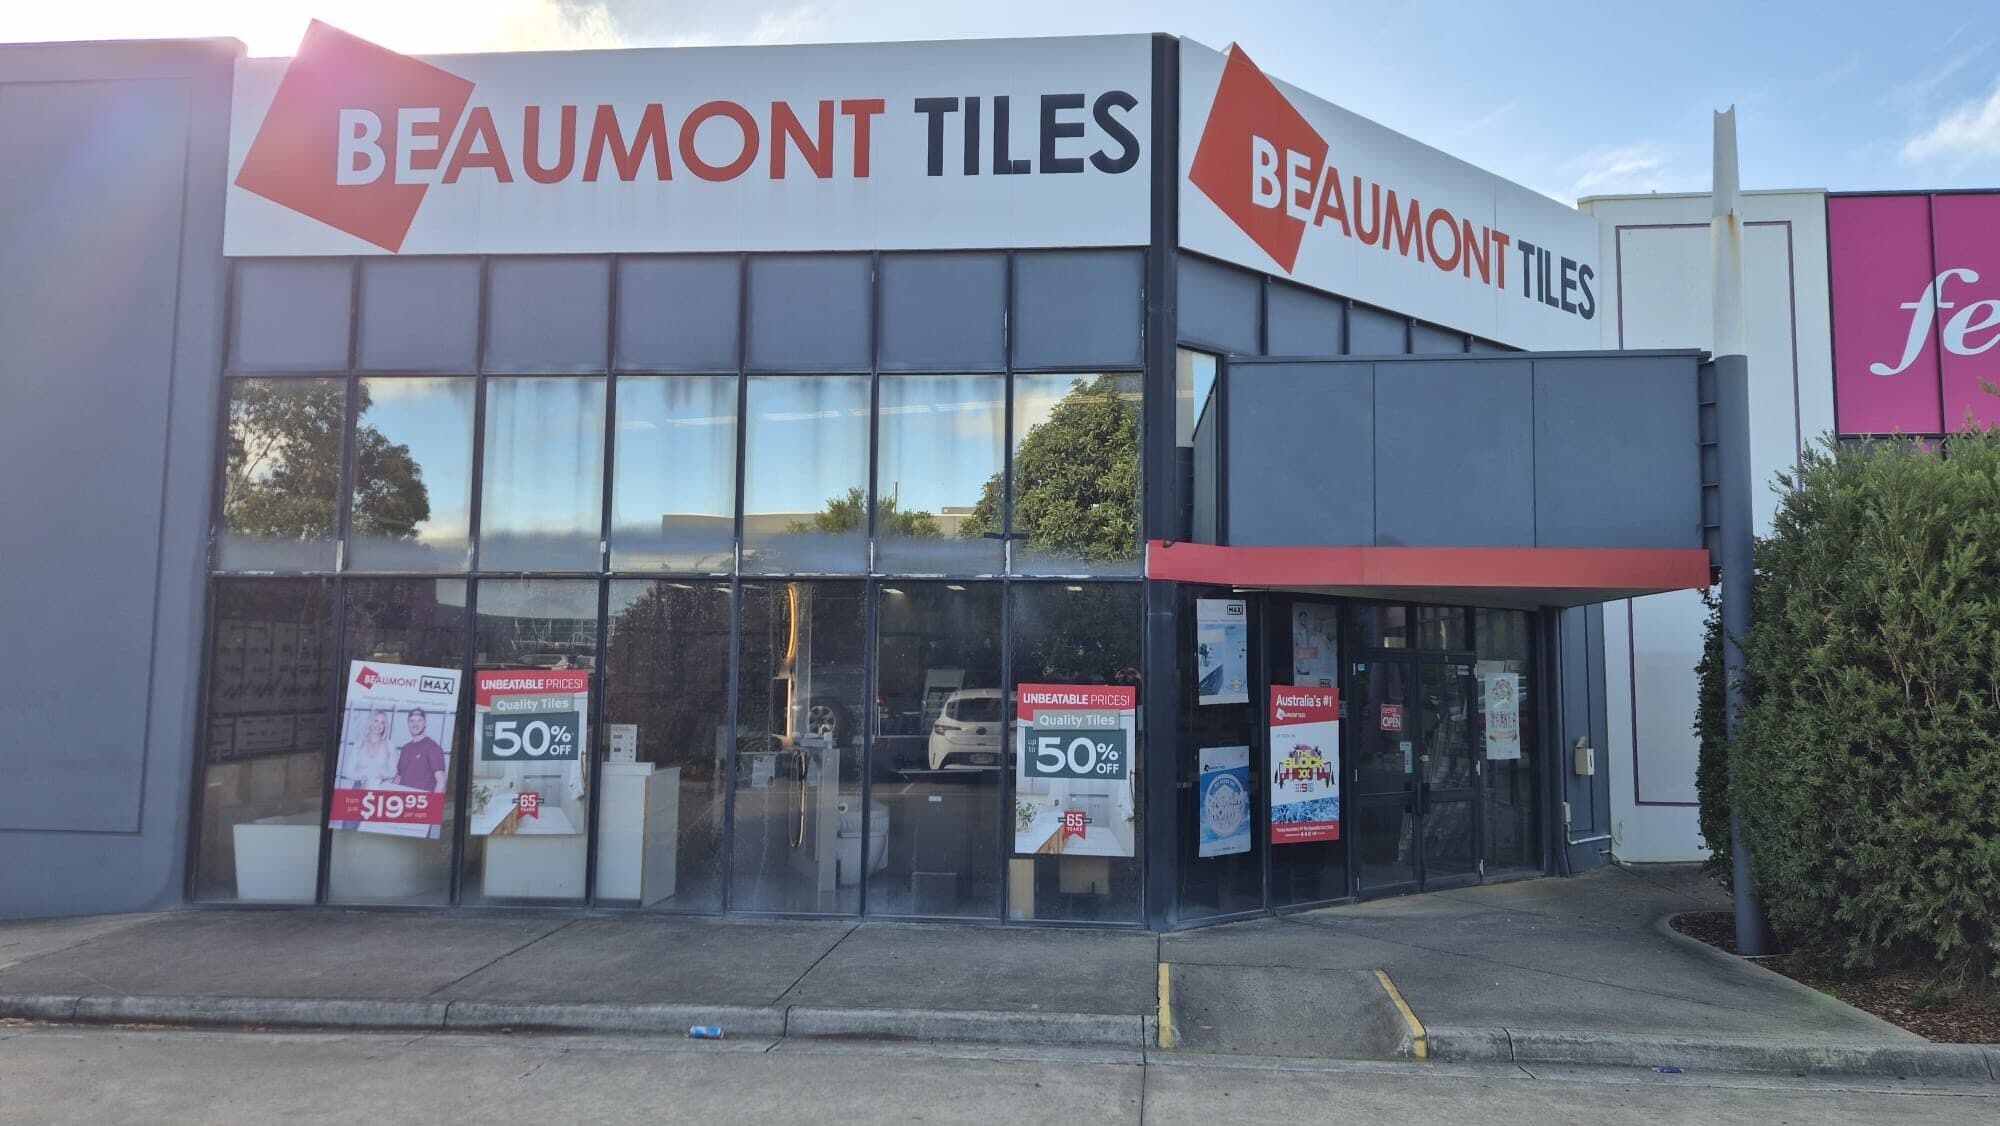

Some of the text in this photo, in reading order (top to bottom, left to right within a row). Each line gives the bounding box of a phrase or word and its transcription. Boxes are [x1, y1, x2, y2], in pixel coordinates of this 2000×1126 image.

[336, 90, 1141, 186] BEAUMONT TILES
[1252, 135, 1596, 321] BEAUMONT TILES
[364, 673, 452, 694] BEAUMONT MAX
[481, 678, 584, 690] UNBEATABLE PRICES!
[496, 697, 569, 713] Quality Tiles
[1023, 693, 1130, 706] UNBEATABLE PRICES!
[1276, 694, 1321, 707] Australia's
[1039, 714, 1116, 728] Quality Tiles
[550, 745, 572, 756] OFF
[1096, 763, 1120, 775] OFF
[519, 794, 537, 808] 65
[1066, 813, 1084, 827] 65
